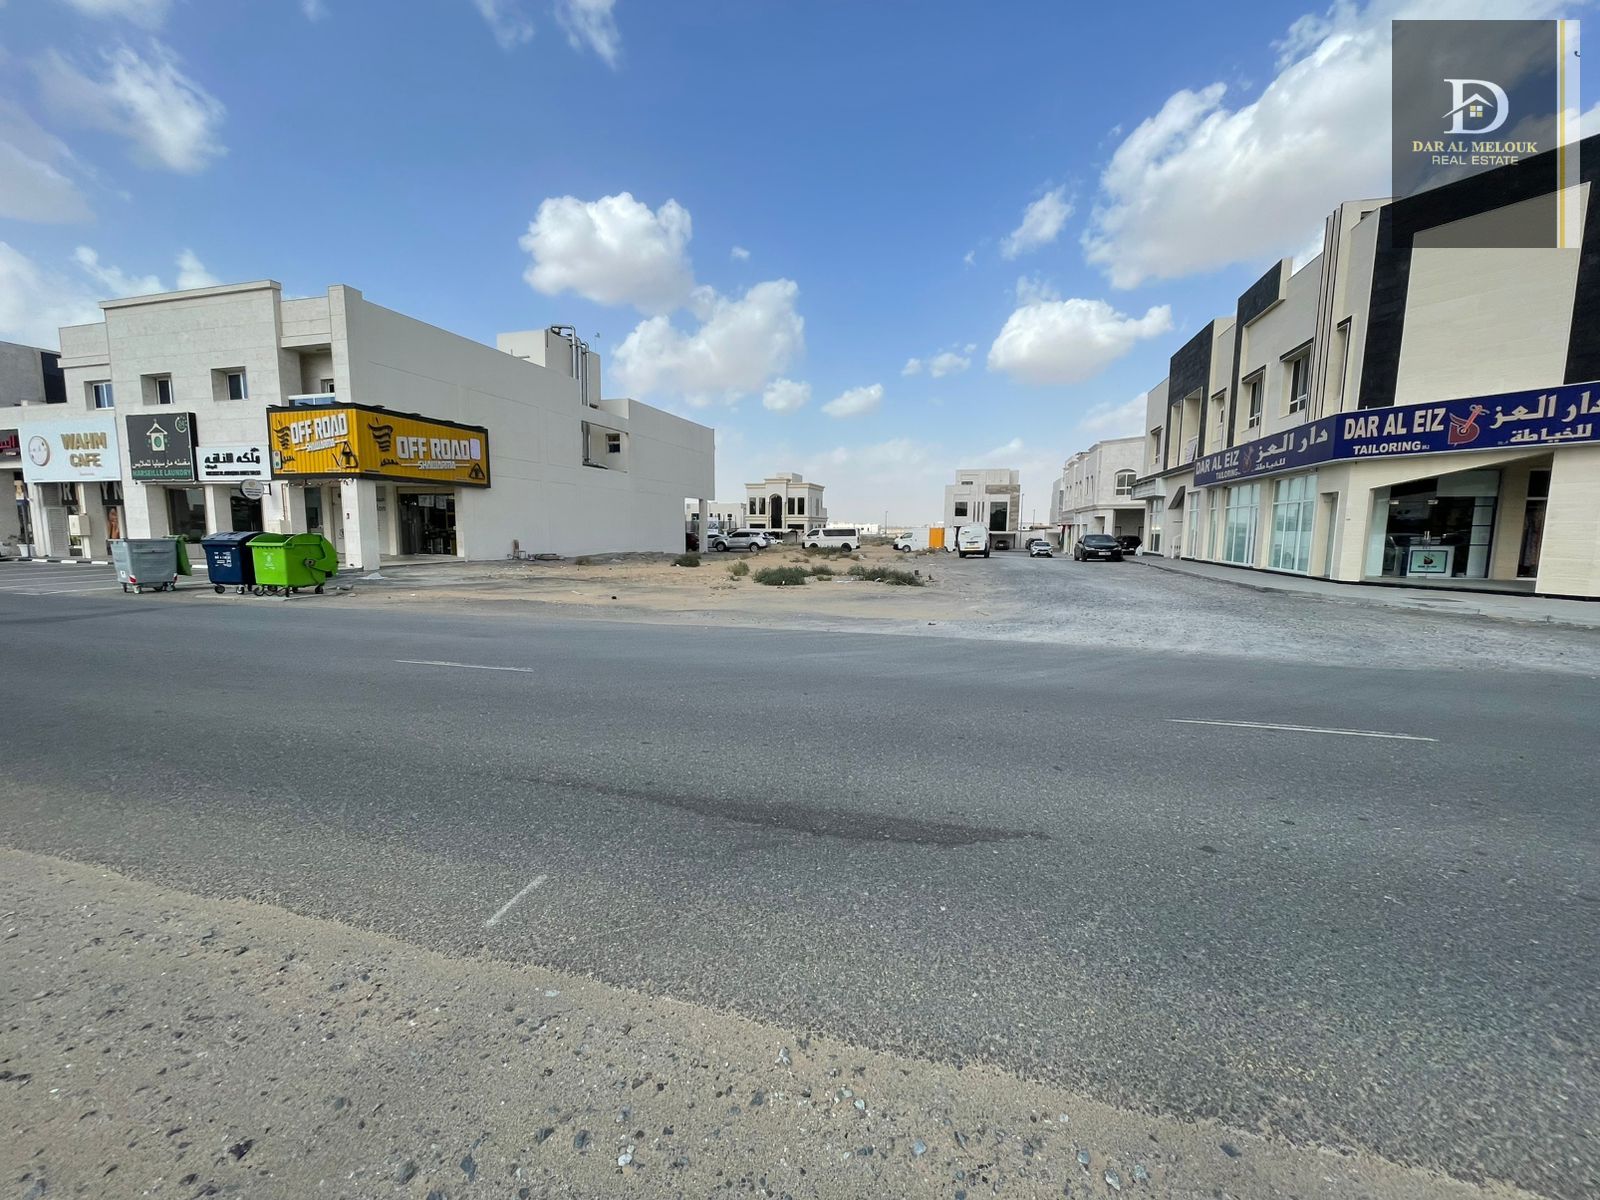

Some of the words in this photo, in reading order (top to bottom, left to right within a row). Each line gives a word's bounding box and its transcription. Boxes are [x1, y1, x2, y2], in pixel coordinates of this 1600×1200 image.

[1344, 416, 1379, 440] DAR
[1382, 412, 1407, 436] AL
[1412, 407, 1447, 433] EIZ
[1489, 394, 1557, 429] العز
[60, 432, 107, 450] WAHM
[290, 420, 312, 445] OFF
[313, 413, 348, 440] ROAD
[1298, 425, 1328, 453] دار
[1510, 423, 1592, 443] للخياطة
[70, 453, 102, 467] CAFE
[396, 436, 427, 459] OFF
[429, 438, 470, 460] ROAD
[1256, 432, 1295, 463] العز
[1353, 441, 1421, 455] TAILORING
[1195, 458, 1211, 475] DAR
[1211, 458, 1222, 473] AL
[1224, 450, 1240, 468] EIZ
